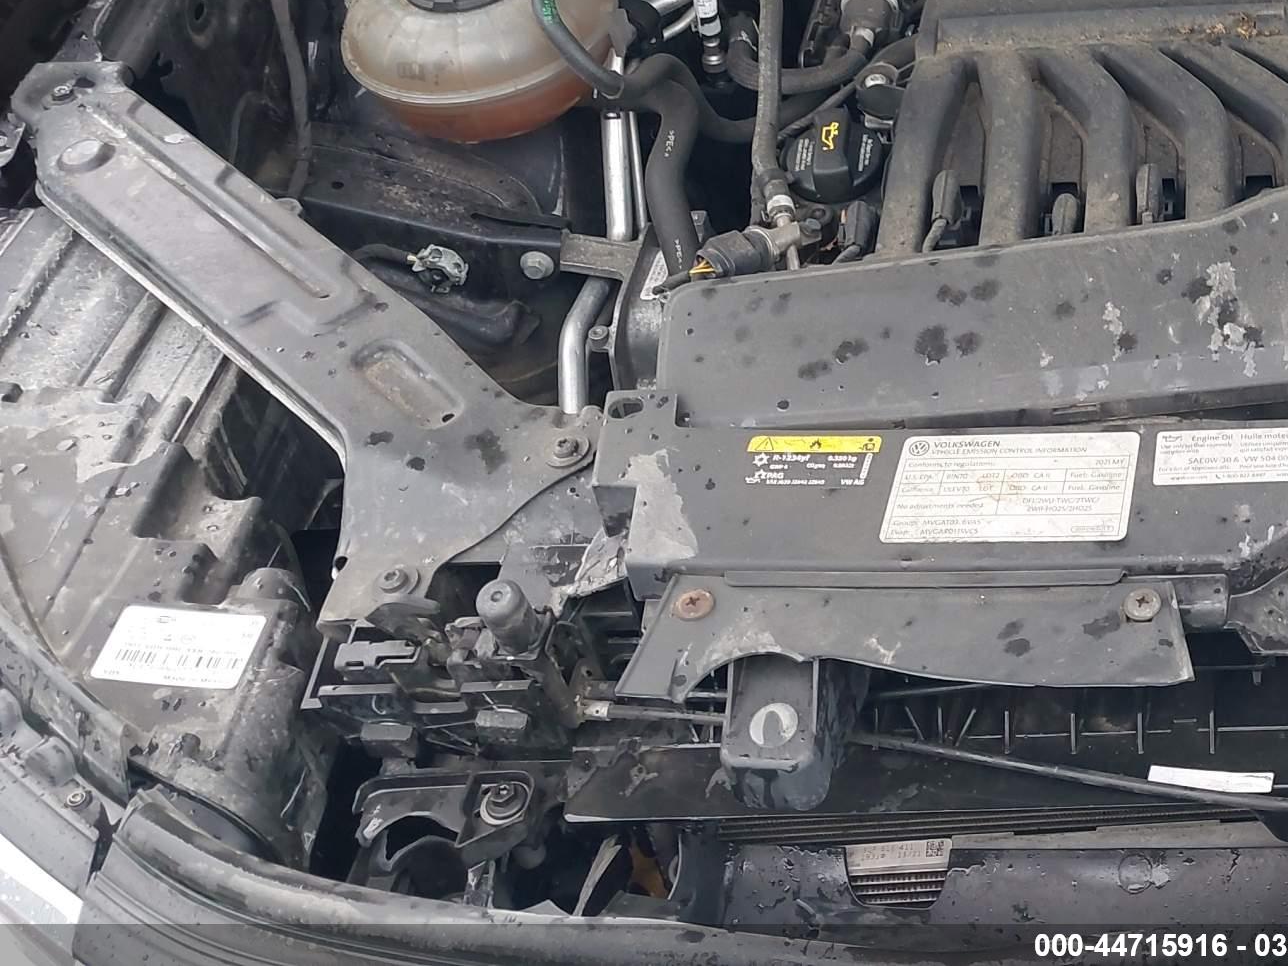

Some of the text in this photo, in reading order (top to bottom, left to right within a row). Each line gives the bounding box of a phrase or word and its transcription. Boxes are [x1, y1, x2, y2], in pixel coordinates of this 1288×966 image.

[1192, 433, 1233, 443] Engine Oil
[933, 440, 1001, 449] VOLKSWAGEN
[931, 448, 961, 456] VEHICLE
[963, 447, 998, 455] EMISSION
[1035, 446, 1089, 454] INFORMATION
[772, 454, 858, 463] R-1234yf kg
[1244, 455, 1259, 463] VW
[767, 471, 785, 480] PAG
[1088, 483, 1121, 491] Gasoline
